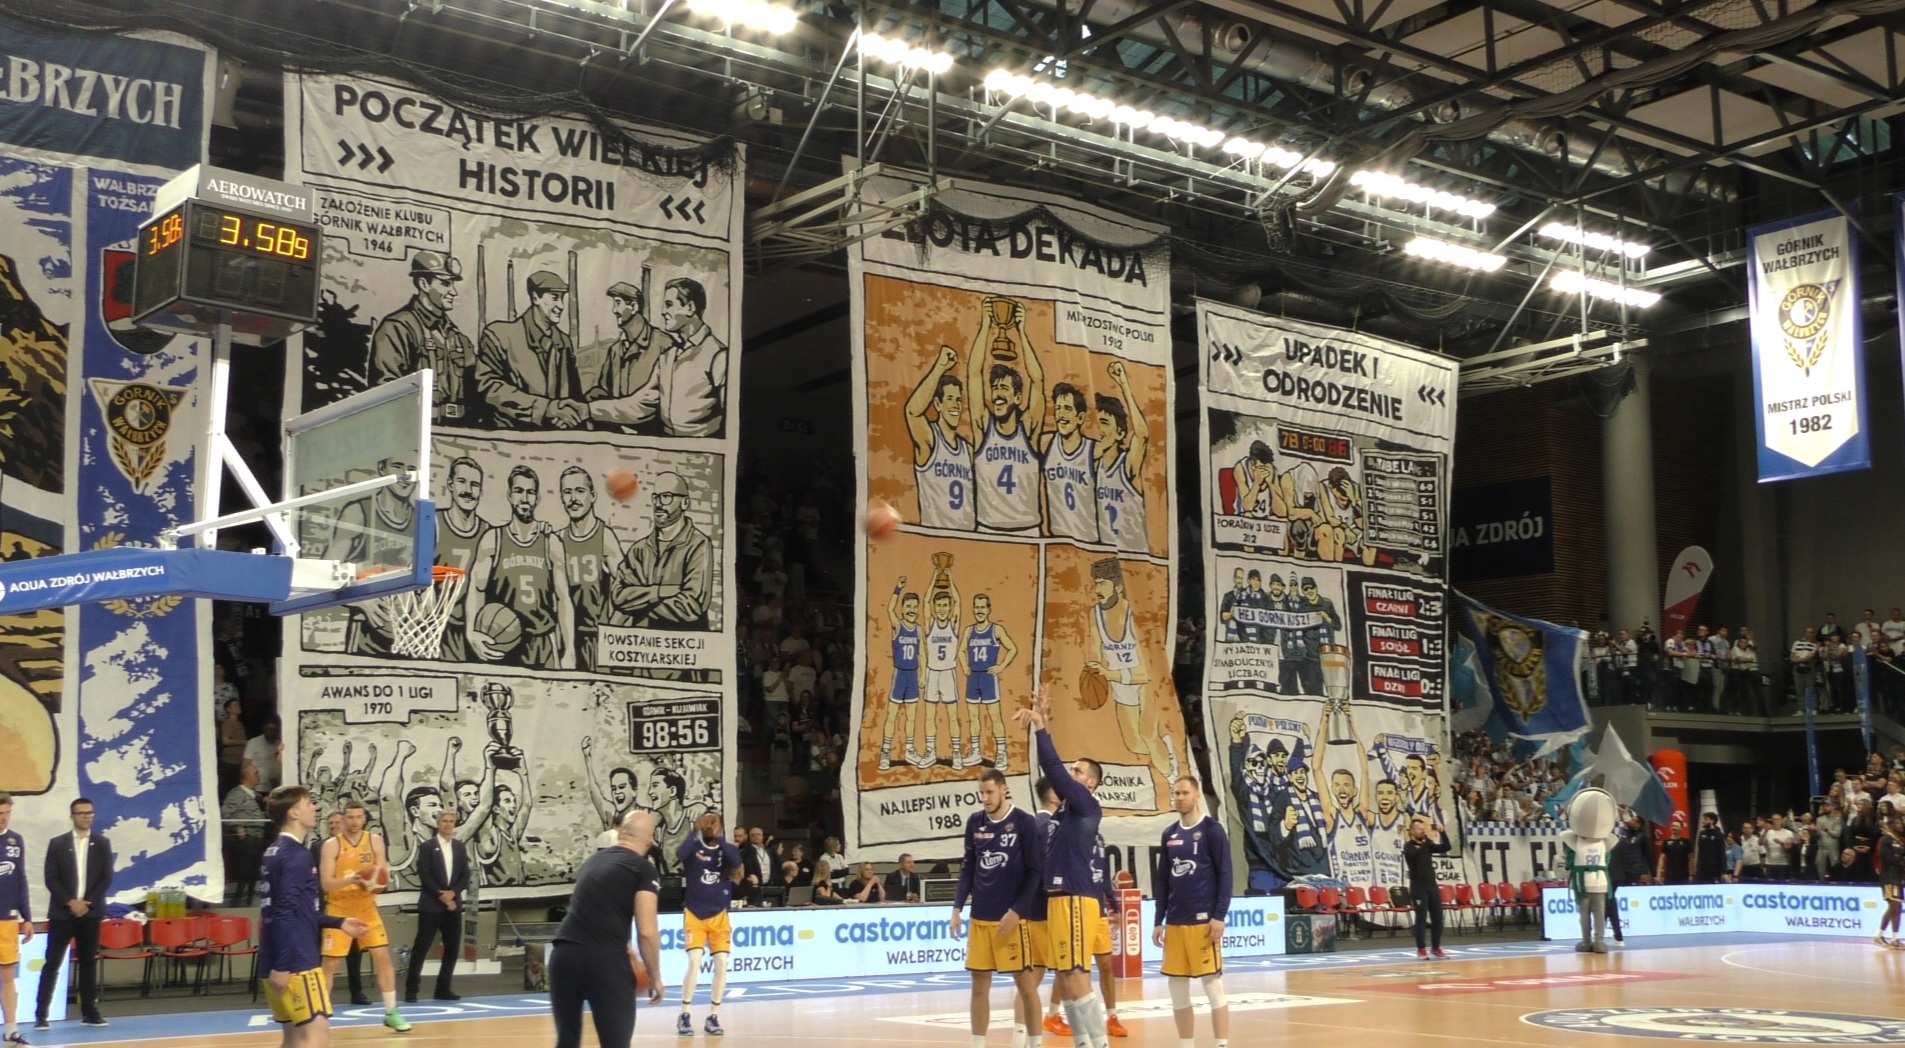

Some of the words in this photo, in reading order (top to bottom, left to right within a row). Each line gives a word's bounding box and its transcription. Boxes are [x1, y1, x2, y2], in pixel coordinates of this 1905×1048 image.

[0, 55, 183, 130] BRZYCH
[334, 83, 542, 151] POCZĄTEK
[93, 176, 160, 196] WAŁBRZ
[206, 178, 307, 210] AEROWATCH
[458, 157, 617, 212] HISTORII
[320, 196, 391, 220] ZAŁOŻENIE
[394, 208, 433, 225] KLUBU
[366, 221, 445, 244] WAŁBRZYCH
[363, 237, 393, 253] 1946
[1776, 233, 1824, 256] GÓRNIK
[1009, 225, 1148, 288] DEKADA
[1763, 245, 1840, 275] WAŁBRZYCH
[1283, 337, 1368, 377] UPADEK
[1373, 356, 1379, 380] I
[114, 387, 167, 410] GÓRNIK
[1262, 368, 1403, 422] ODRODZENIE
[1767, 398, 1808, 414] MISTRZ
[1812, 390, 1851, 408] POLSKI
[1789, 413, 1833, 436] 1982
[986, 442, 1030, 465] GÓRNIK
[934, 458, 974, 482] GÓRNIK
[997, 464, 1016, 495] 4
[1046, 462, 1089, 486] GÓRNIK
[948, 479, 964, 511] 9
[1063, 481, 1076, 511] 6
[1475, 510, 1544, 546] ZDRÓJ
[501, 553, 545, 572] GÓRNIK
[568, 552, 598, 584] 13
[9, 580, 48, 594] AQUA
[50, 572, 90, 588] ZDRÓJ
[93, 565, 165, 582] WAŁBRZYCH
[519, 574, 535, 604] 5
[1399, 591, 1414, 601] LIG
[664, 637, 705, 650] SEKCJI
[1401, 629, 1418, 640] LIG
[902, 644, 916, 660] 10
[937, 645, 947, 661] 5
[972, 646, 988, 662] 14
[321, 686, 370, 699] AWANS
[373, 684, 394, 699] DO
[408, 686, 433, 700] LIGI
[363, 701, 393, 716] 1970
[642, 719, 709, 748] 98:56
[881, 795, 936, 817] NAJLEPSI
[939, 795, 951, 810] W
[928, 815, 962, 831] 1988
[999, 833, 1018, 848] 37
[1649, 892, 1724, 911] castorama
[1742, 889, 1860, 912] castorama
[1677, 914, 1726, 928] WAŁBRZYCH
[1784, 915, 1863, 930] WAŁBRZYCH
[699, 954, 795, 974] WBRZYCH
